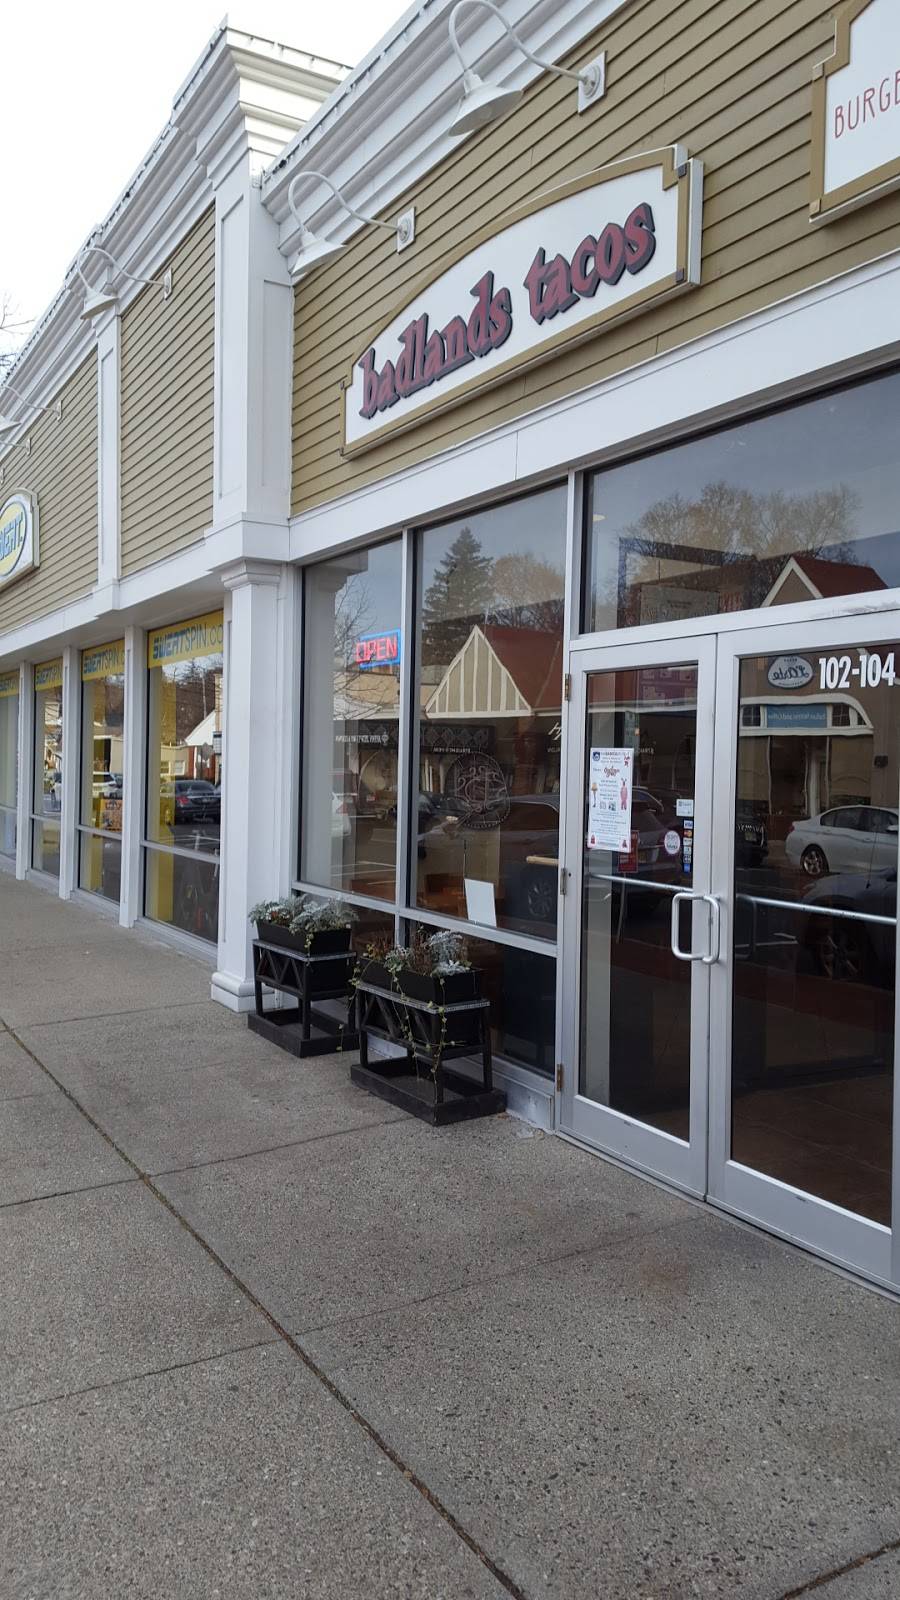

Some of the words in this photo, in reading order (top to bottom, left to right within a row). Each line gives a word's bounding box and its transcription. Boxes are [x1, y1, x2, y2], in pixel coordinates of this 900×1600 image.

[358, 270, 513, 420] badlands
[523, 202, 656, 325] tacos
[356, 634, 398, 663] OPEN
[818, 652, 896, 690] 102-104
